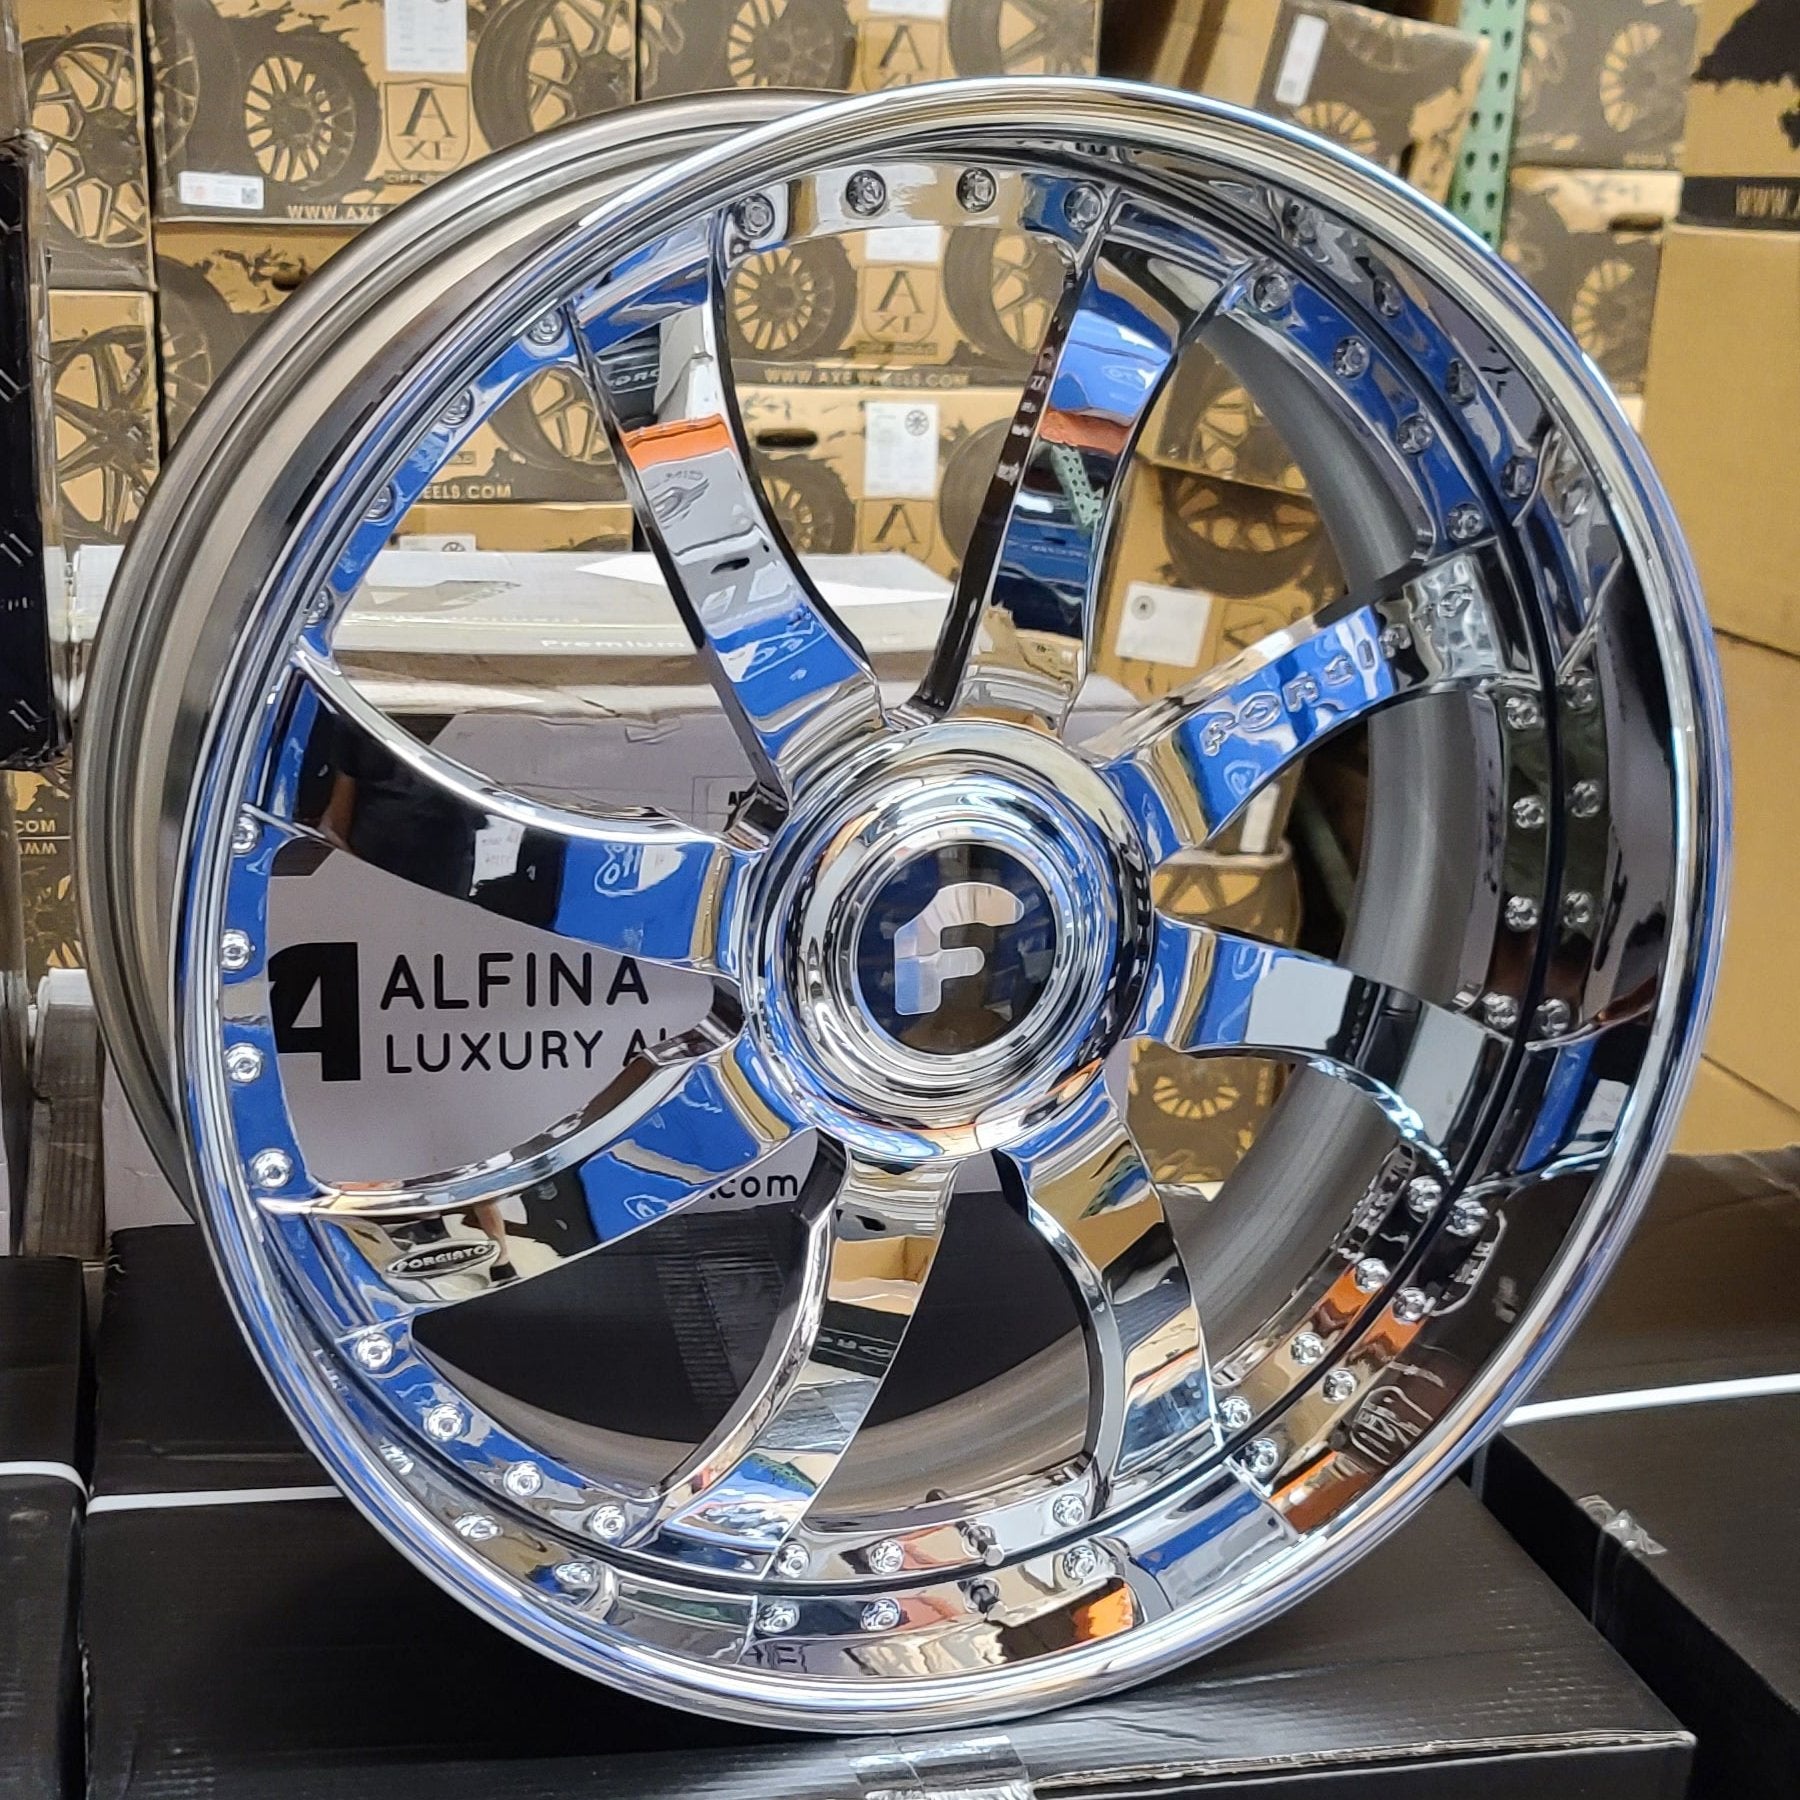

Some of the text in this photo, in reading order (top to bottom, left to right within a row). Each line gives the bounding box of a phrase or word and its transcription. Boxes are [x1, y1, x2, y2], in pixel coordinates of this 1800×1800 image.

[380, 951, 649, 1010] ALFINA
[386, 1030, 604, 1074] LUXURY
[708, 1174, 799, 1199] .com
